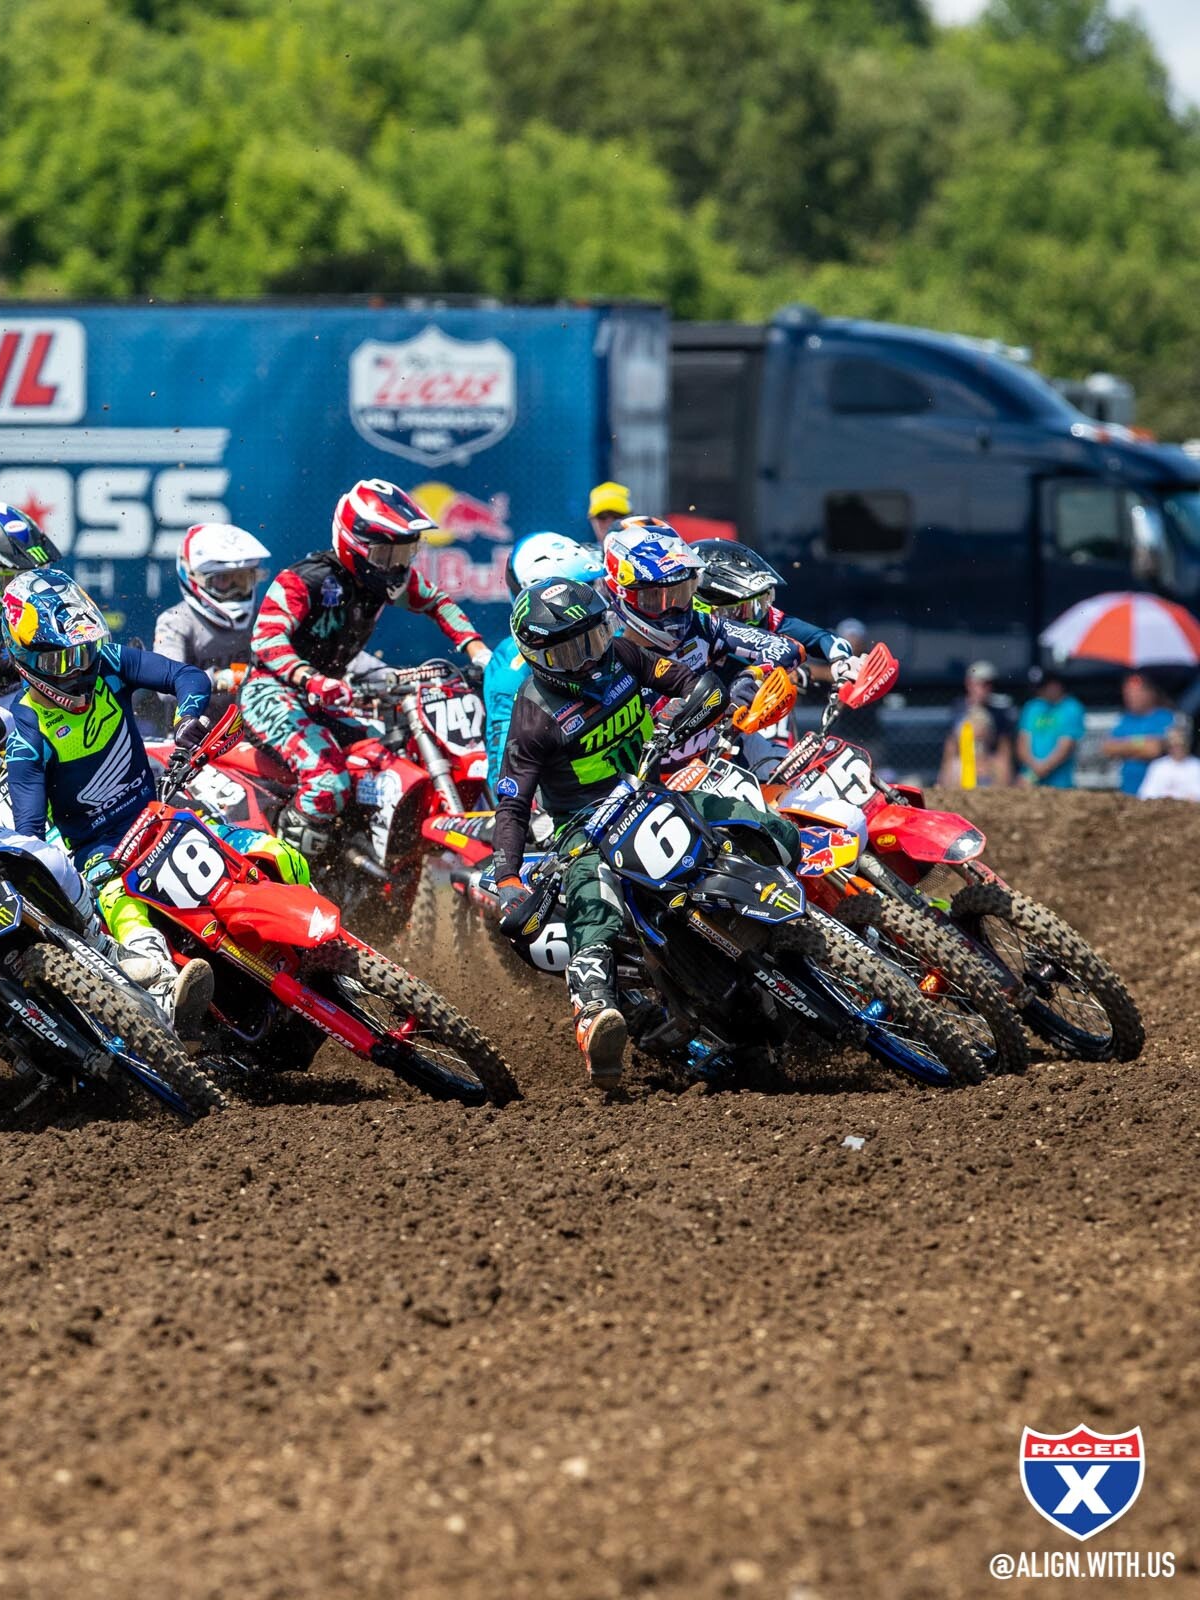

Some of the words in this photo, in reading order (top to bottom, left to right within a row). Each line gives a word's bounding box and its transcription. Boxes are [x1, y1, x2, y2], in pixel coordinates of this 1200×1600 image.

[610, 674, 635, 702] YAMAHA
[862, 667, 898, 704] ACERBIS
[579, 694, 643, 753] THOR
[616, 811, 638, 836] LUCAS
[634, 800, 649, 815] OIL
[633, 801, 692, 880] 6
[144, 842, 165, 871] LUCAS
[162, 830, 176, 848] OIL
[155, 827, 226, 910] 18
[210, 880, 230, 904] HONDA
[68, 937, 131, 986] DUNLOP
[529, 922, 572, 972] 6
[8, 999, 69, 1049] DUNLOP
[290, 1003, 356, 1050] DUNLOP
